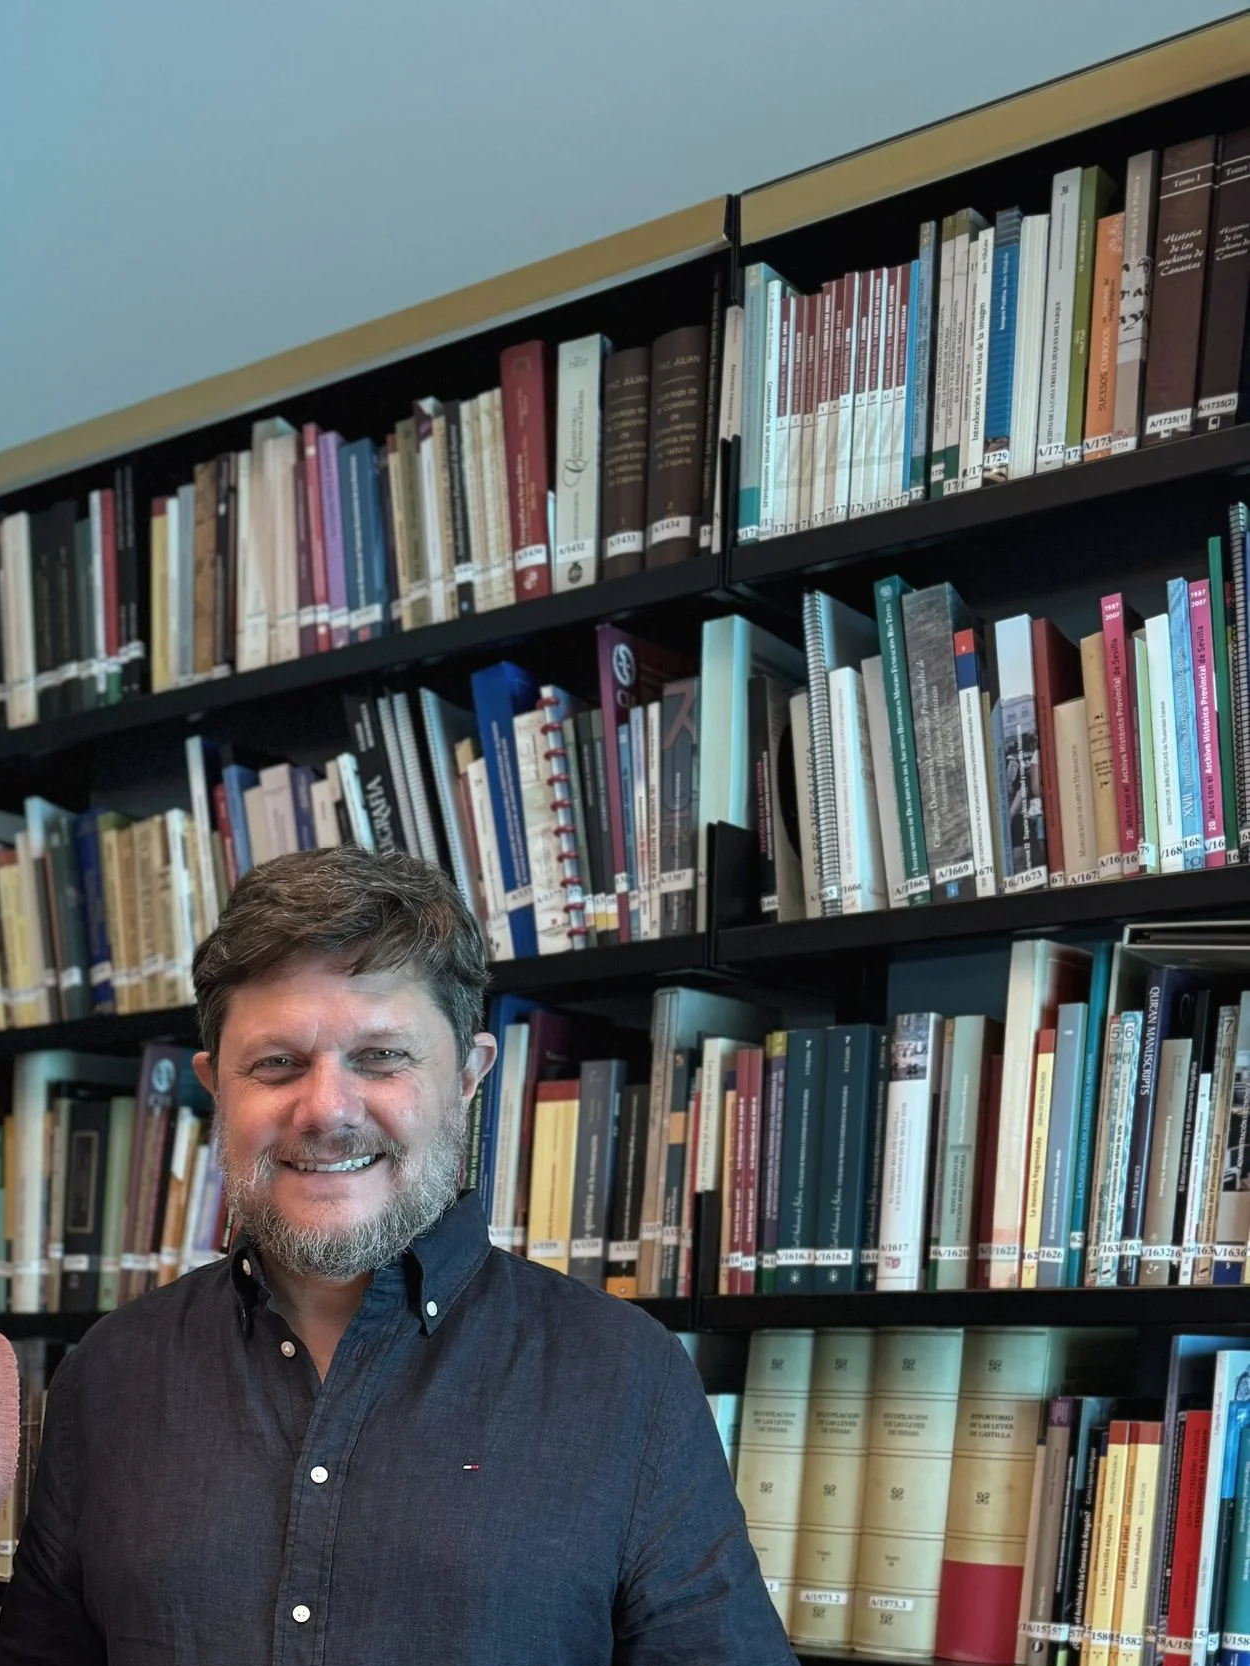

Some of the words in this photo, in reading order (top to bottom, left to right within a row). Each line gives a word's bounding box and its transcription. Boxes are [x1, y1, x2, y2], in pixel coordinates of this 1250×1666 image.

[1173, 176, 1194, 188] Tomo
[1163, 228, 1203, 244] Historia
[1158, 253, 1191, 267] archivos
[1160, 262, 1201, 277] Canarias
[978, 302, 987, 330] imagen
[976, 343, 985, 351] de
[975, 353, 984, 375] teoría
[974, 377, 983, 385] la
[1098, 372, 1110, 412] SUCESOS
[971, 394, 982, 441] Introducción
[1110, 638, 1119, 664] Sevilla
[1197, 626, 1205, 652] Sevilla
[1112, 666, 1120, 676] de
[1198, 654, 1206, 664] de
[1113, 677, 1123, 716] Provincial
[1200, 665, 1208, 705] Provincial
[1117, 717, 1126, 752] Histórico
[1202, 706, 1210, 742] Histórico
[1120, 754, 1129, 783] Archivo
[1183, 793, 1194, 817] XVII
[1209, 821, 1216, 831] 20
[937, 863, 969, 878] A/1669
[1111, 1026, 1120, 1040] 5
[1124, 1025, 1134, 1039] 6
[1225, 1019, 1232, 1032] 7
[1140, 1027, 1158, 1096] MANUSCRIPTS
[1189, 1061, 1198, 1092] fotográfico
[1032, 1137, 1042, 1178] fragmentada
[1030, 1180, 1039, 1208] memoria
[1030, 1209, 1036, 1217] La
[1078, 1550, 1088, 1574] Corona
[1099, 1587, 1106, 1596] La
[1104, 1514, 1114, 1545] expositiva
[1075, 1592, 1084, 1616] Archivo
